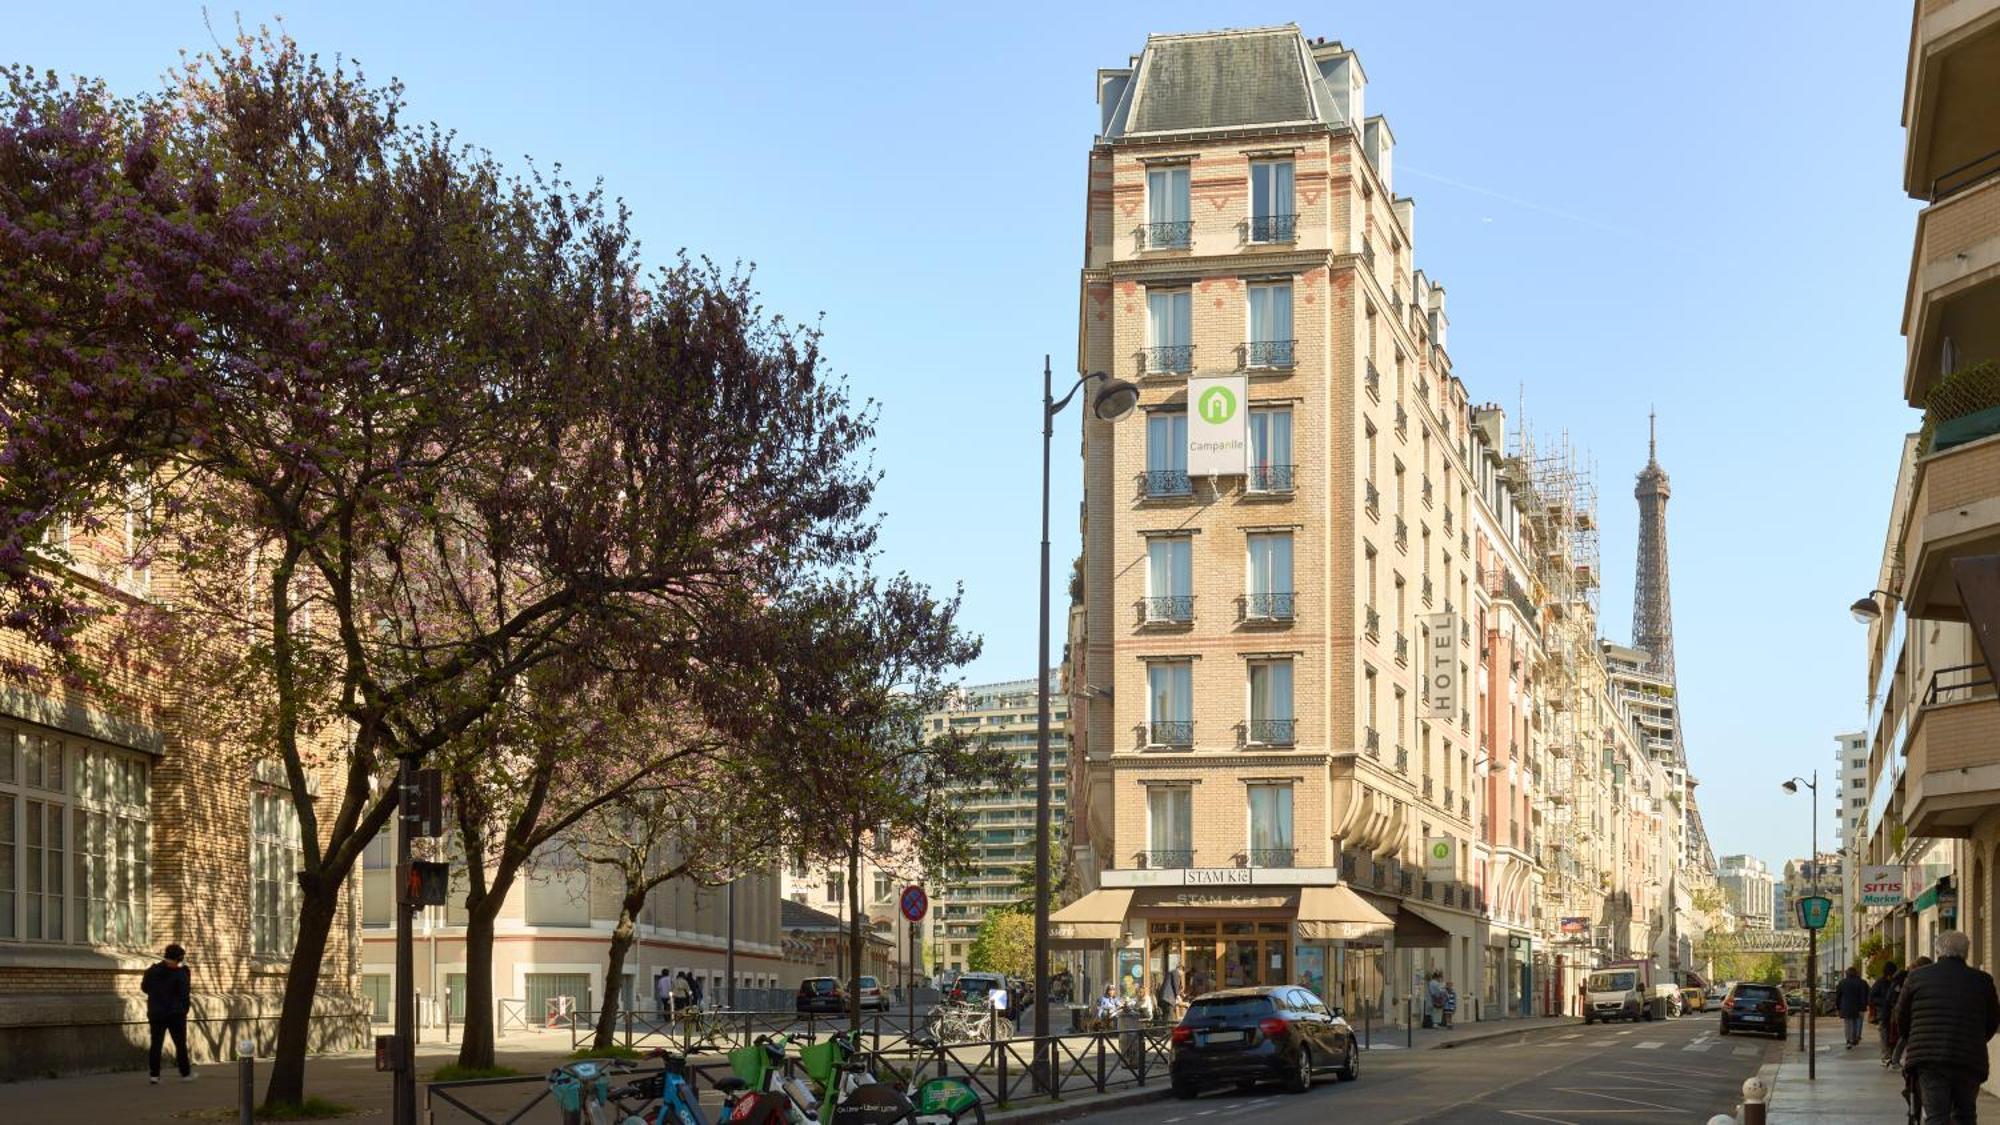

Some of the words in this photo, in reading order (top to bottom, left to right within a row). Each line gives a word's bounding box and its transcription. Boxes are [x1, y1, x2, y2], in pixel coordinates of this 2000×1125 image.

[1190, 440, 1245, 453] Campanile
[1435, 617, 1451, 710] HOTEL
[1188, 871, 1225, 883] STAM
[1863, 883, 1902, 893] SITIS
[1177, 894, 1222, 905] STAM
[1863, 895, 1901, 904] Market
